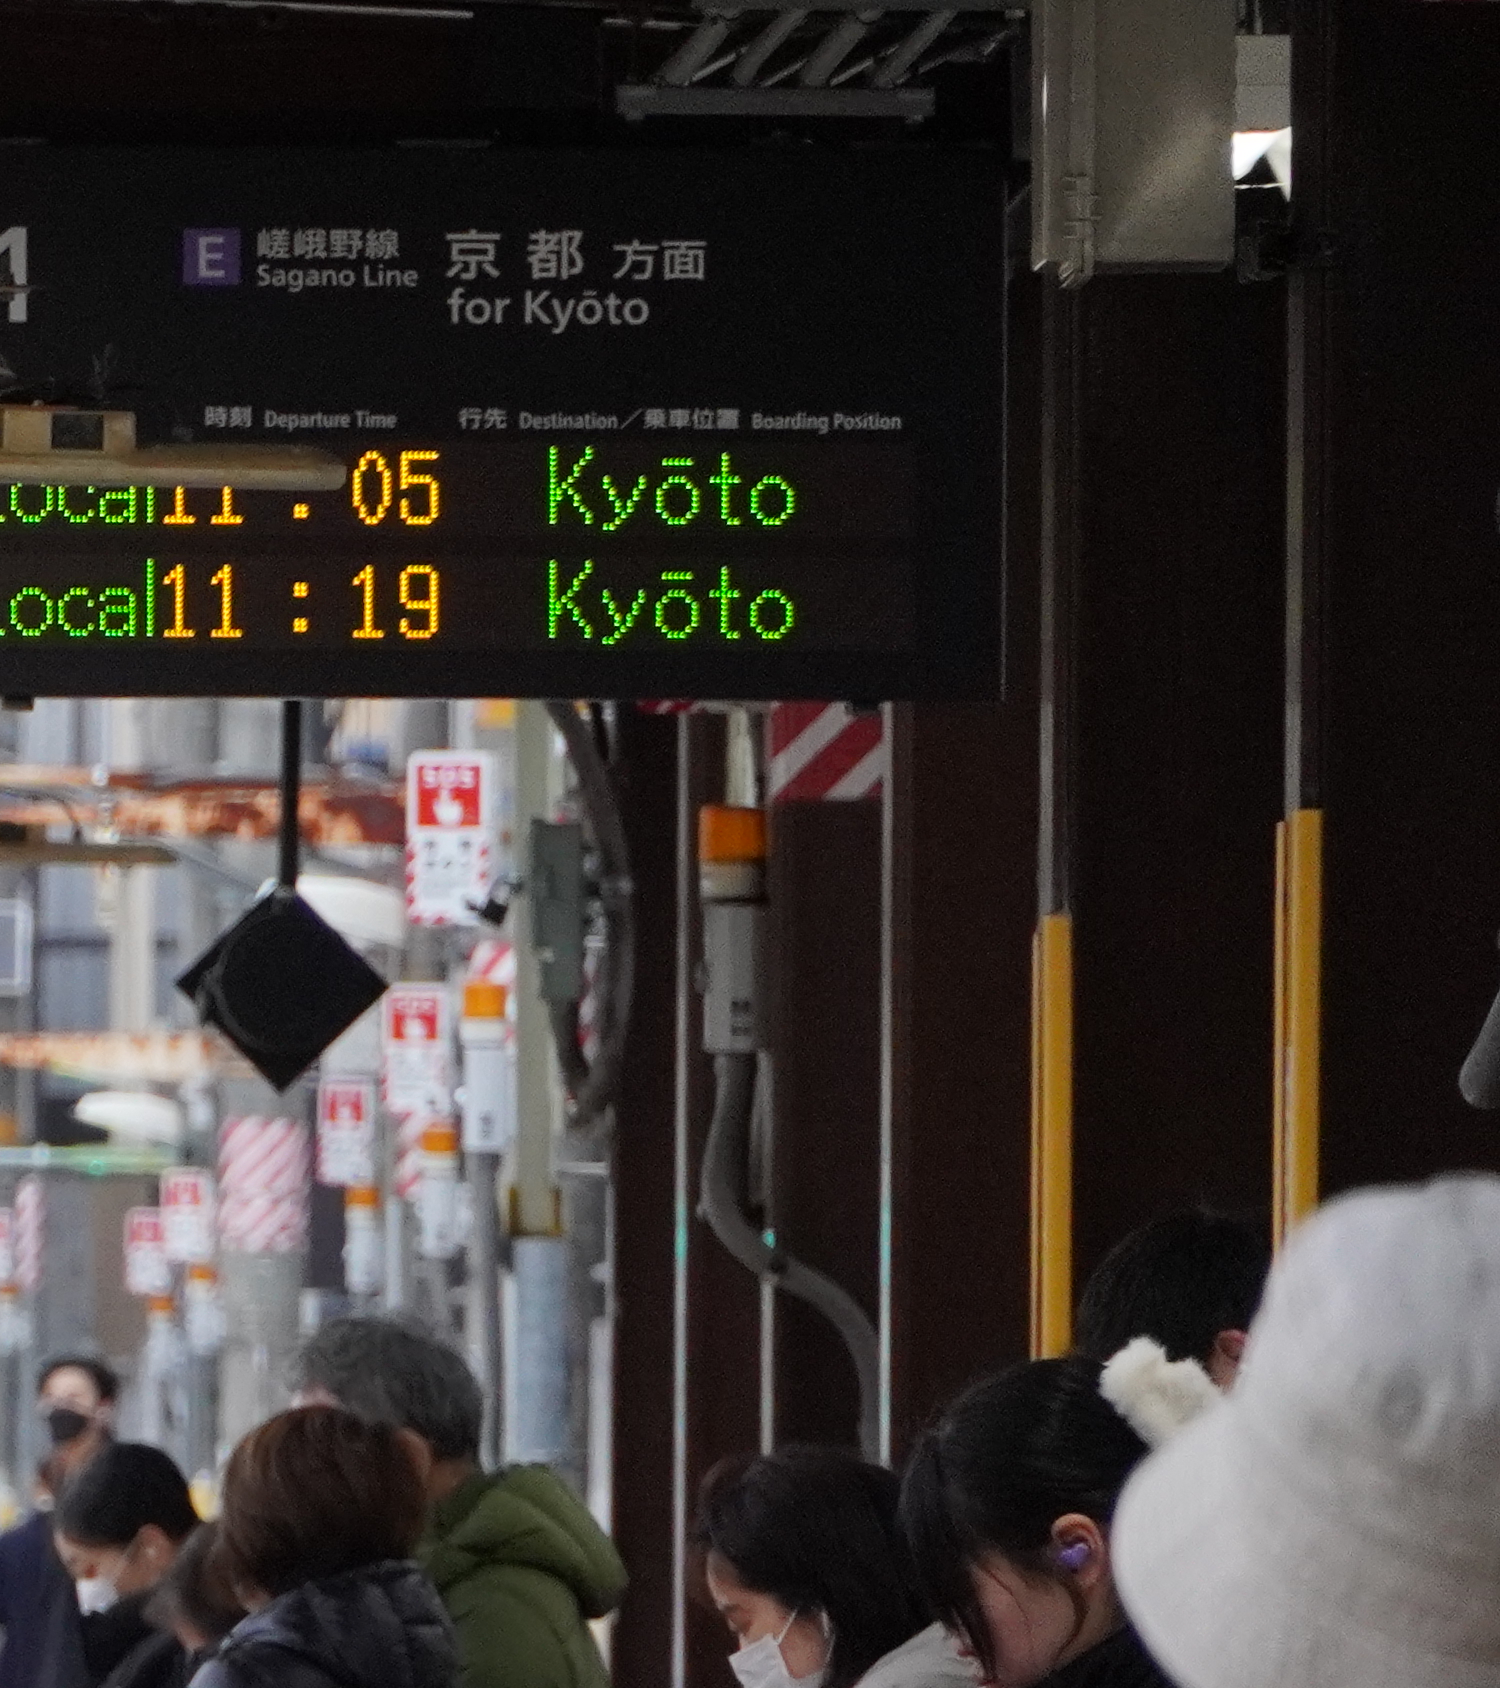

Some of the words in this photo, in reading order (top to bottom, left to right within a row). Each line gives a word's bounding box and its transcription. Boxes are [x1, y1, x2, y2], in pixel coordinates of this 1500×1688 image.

[198, 236, 226, 278] E
[256, 228, 400, 260] 嵯峨野線
[256, 263, 357, 293] Sagano
[363, 263, 419, 287] Line
[447, 289, 511, 325] for
[523, 289, 650, 334] Kyōto
[203, 406, 253, 428] 時刻
[264, 409, 351, 432] Departure
[354, 409, 398, 429] Time
[458, 407, 508, 430] 行先
[751, 412, 829, 434] Boarding
[833, 412, 902, 431] Position
[547, 445, 797, 531] Kyōto
[547, 558, 796, 645] Kyōto
